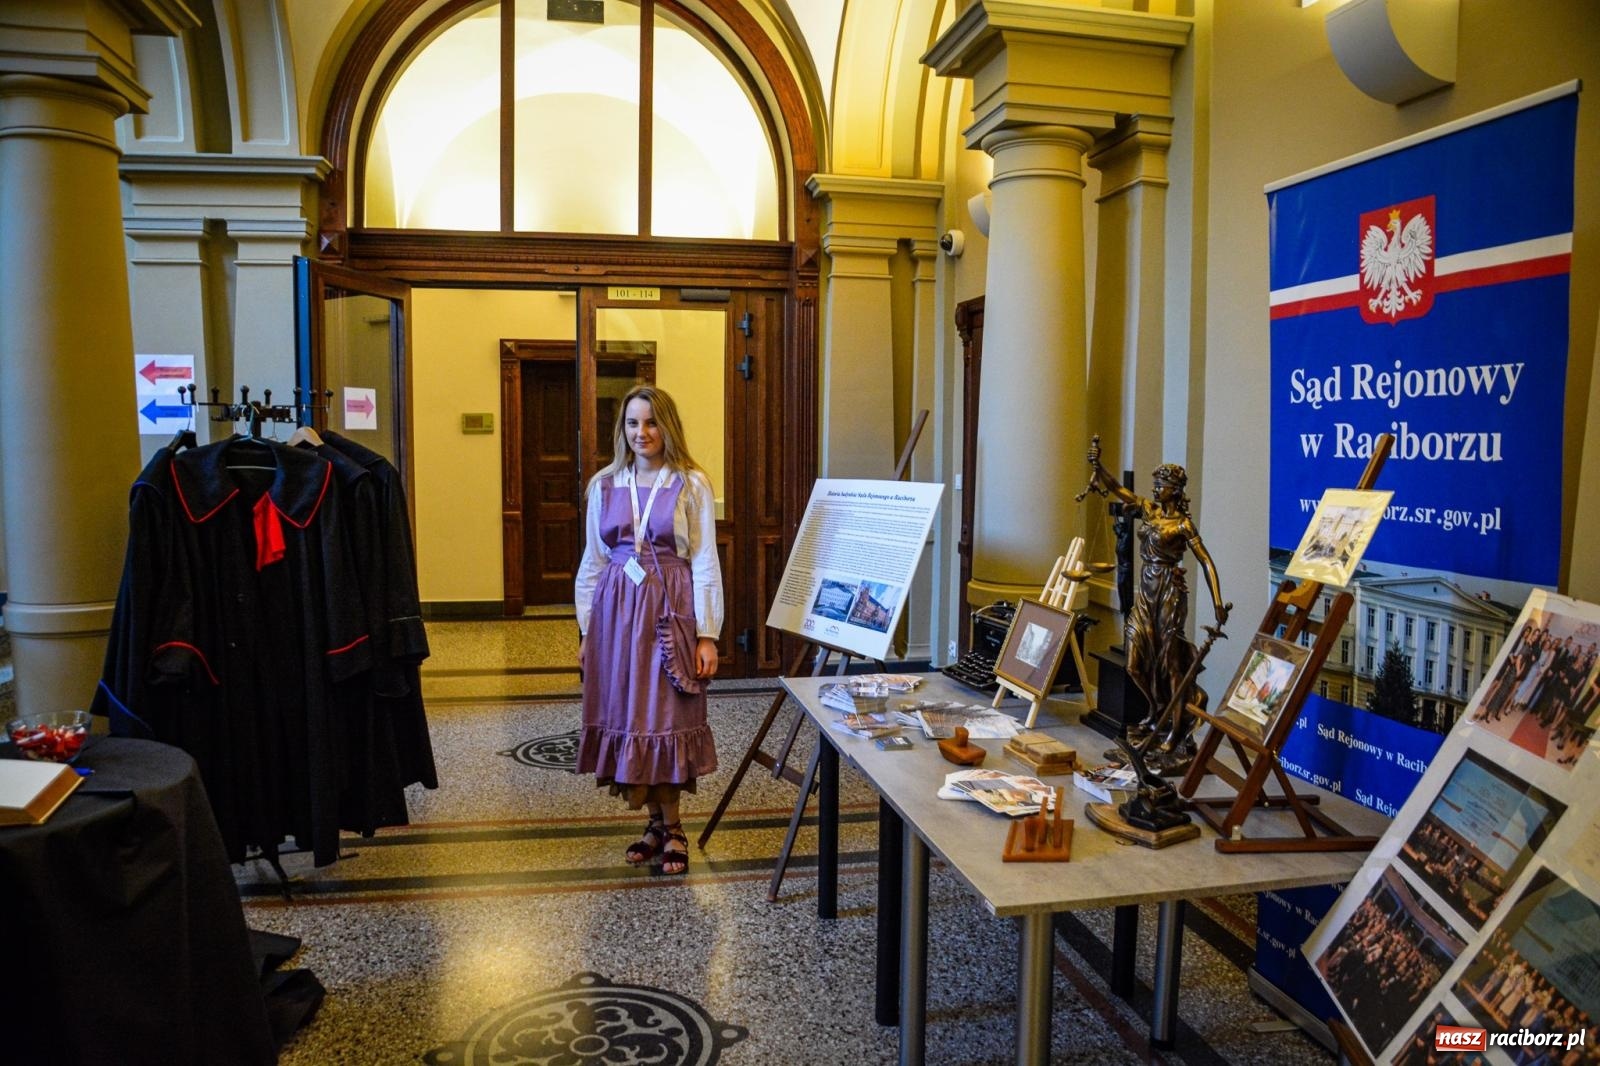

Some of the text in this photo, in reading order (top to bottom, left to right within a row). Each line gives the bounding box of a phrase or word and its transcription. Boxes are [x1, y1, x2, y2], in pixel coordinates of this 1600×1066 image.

[616, 289, 630, 298] 101
[639, 289, 653, 298] 114
[1290, 360, 1525, 410] Sąd Rejonowy
[1300, 433, 1324, 458] w
[1317, 723, 1335, 740] Sąd
[1338, 730, 1383, 760] Rejonowy
[1386, 751, 1394, 761] w
[1397, 752, 1428, 773] Racib
[1280, 756, 1342, 793] iborz.sr.gov.pl
[1355, 788, 1398, 817] Sąd Rejo
